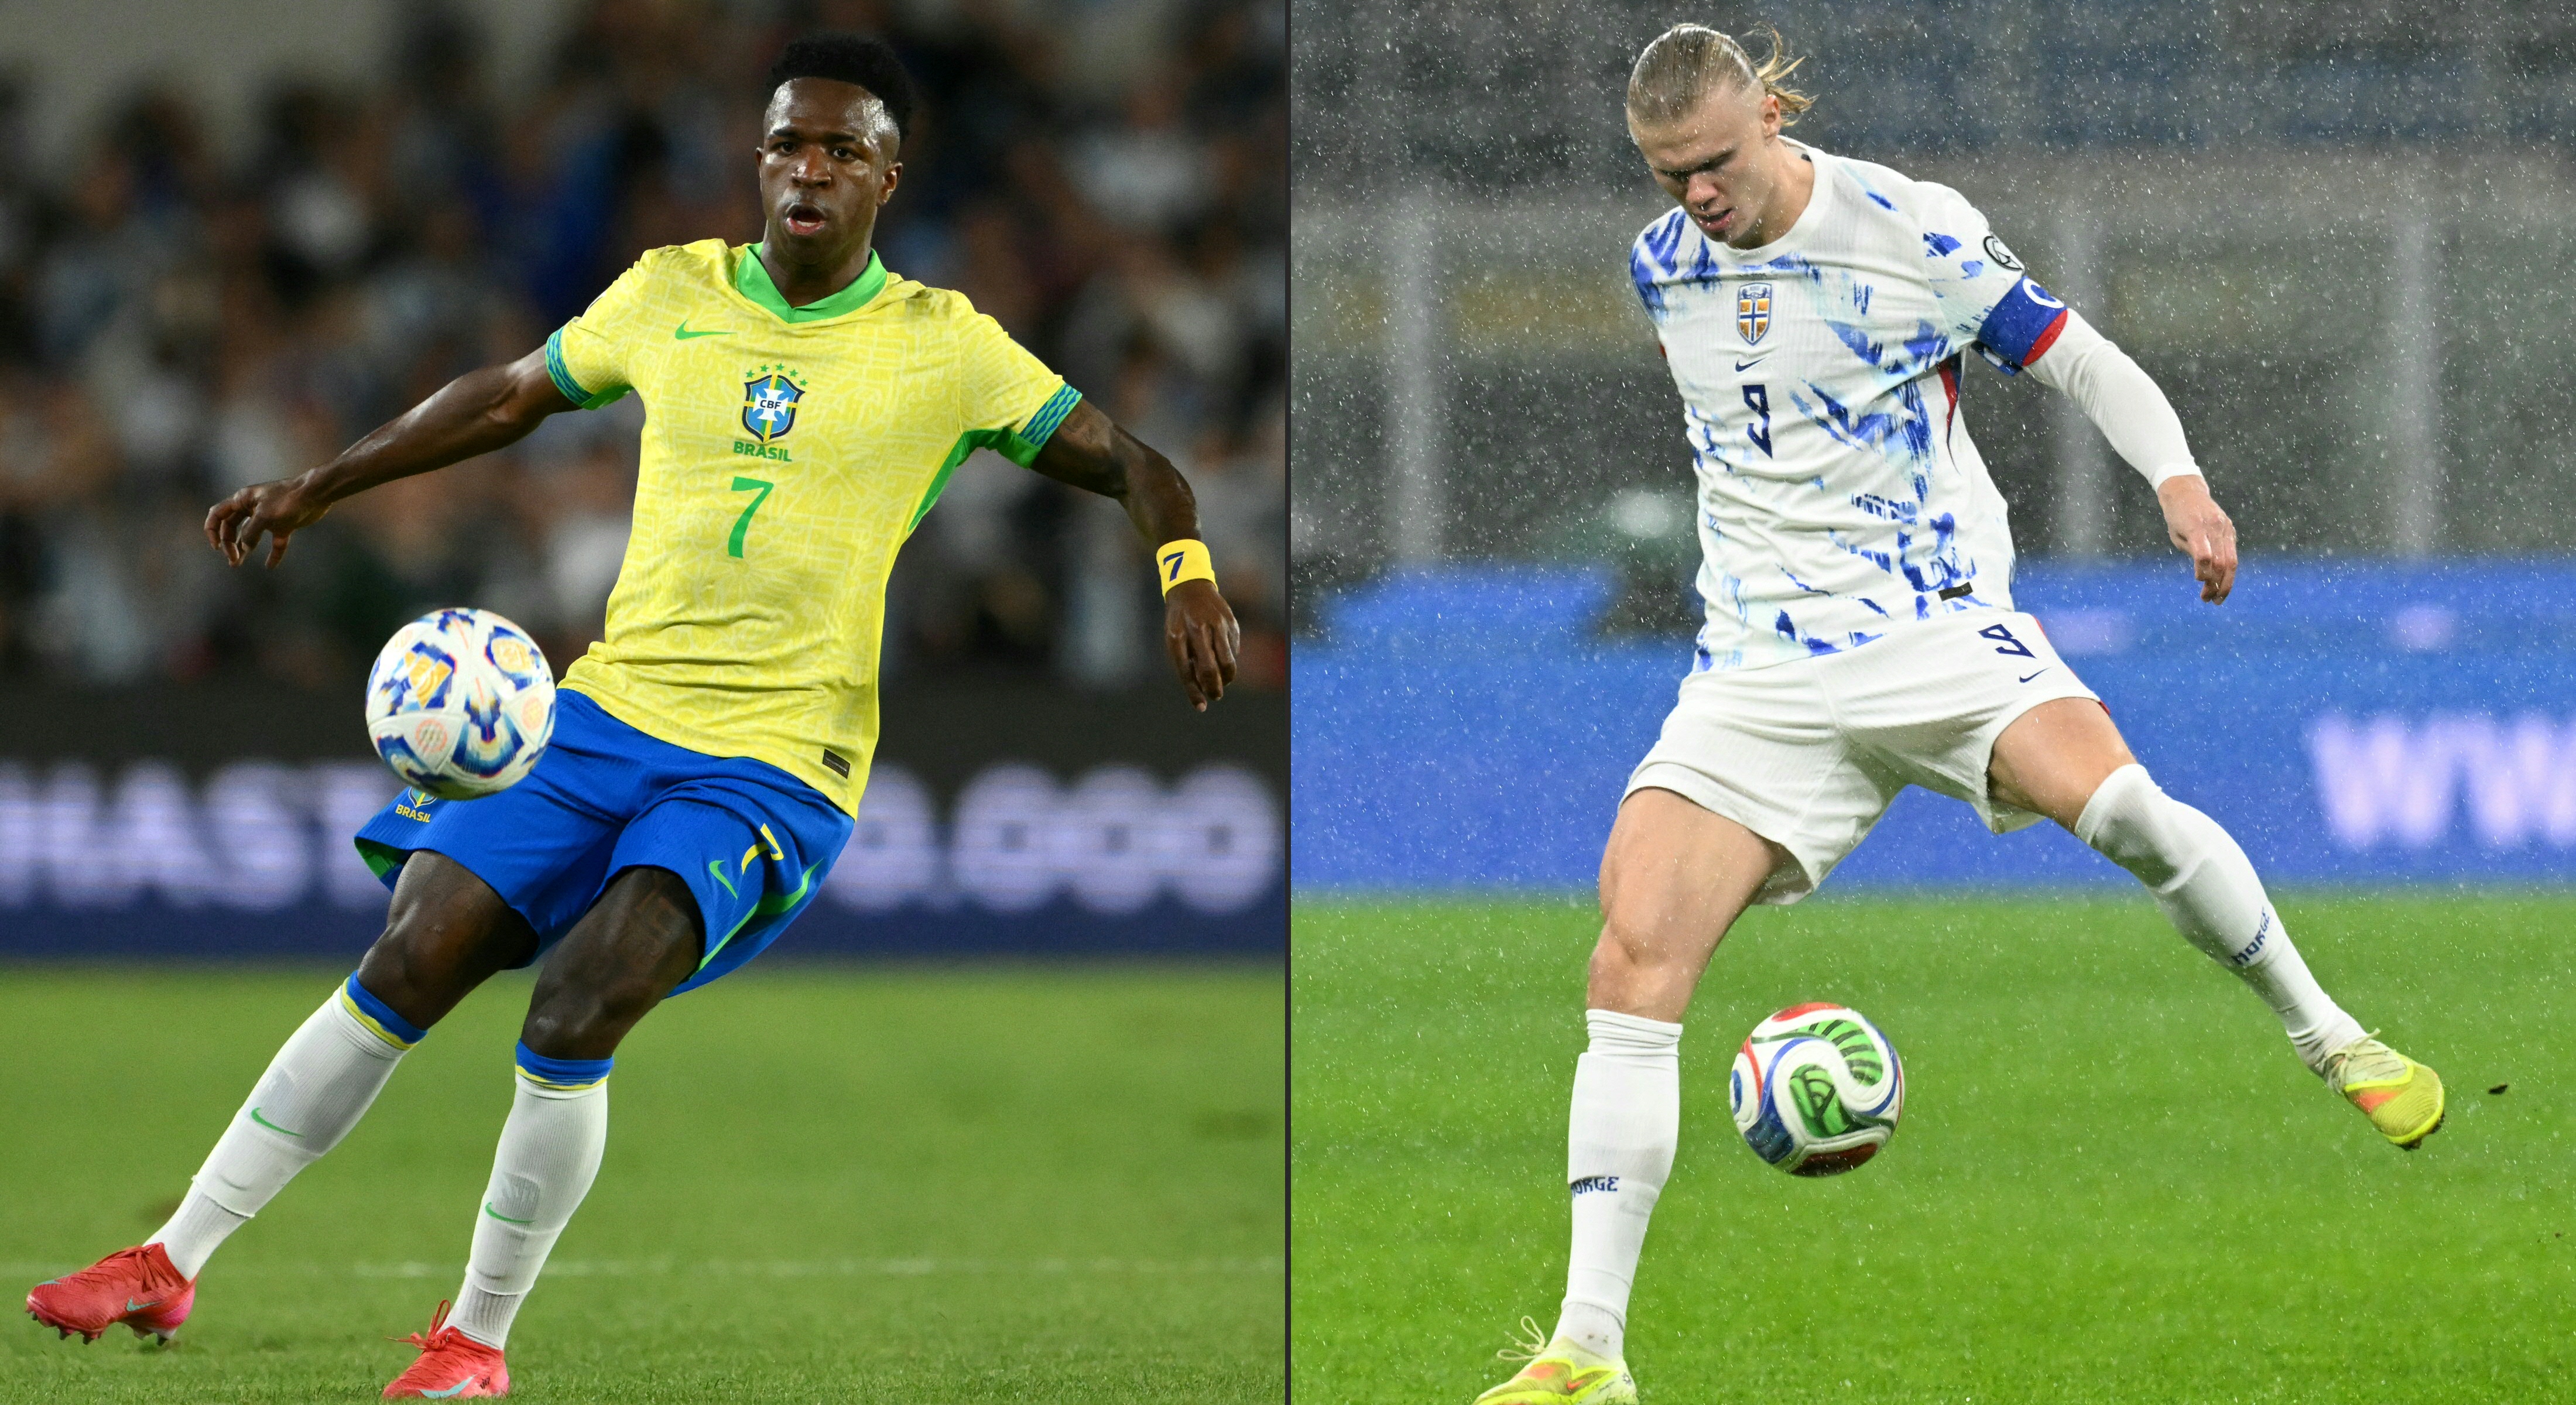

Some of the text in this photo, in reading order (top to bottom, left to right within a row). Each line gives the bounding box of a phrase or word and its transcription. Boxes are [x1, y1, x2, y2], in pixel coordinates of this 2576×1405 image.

[759, 399, 782, 410] CBF
[1742, 383, 1773, 460] 9
[733, 440, 793, 462] BRASIL
[727, 475, 775, 559] 7
[1163, 550, 1185, 582] 7
[1977, 623, 2037, 659] 9
[395, 803, 431, 824] BRASIL
